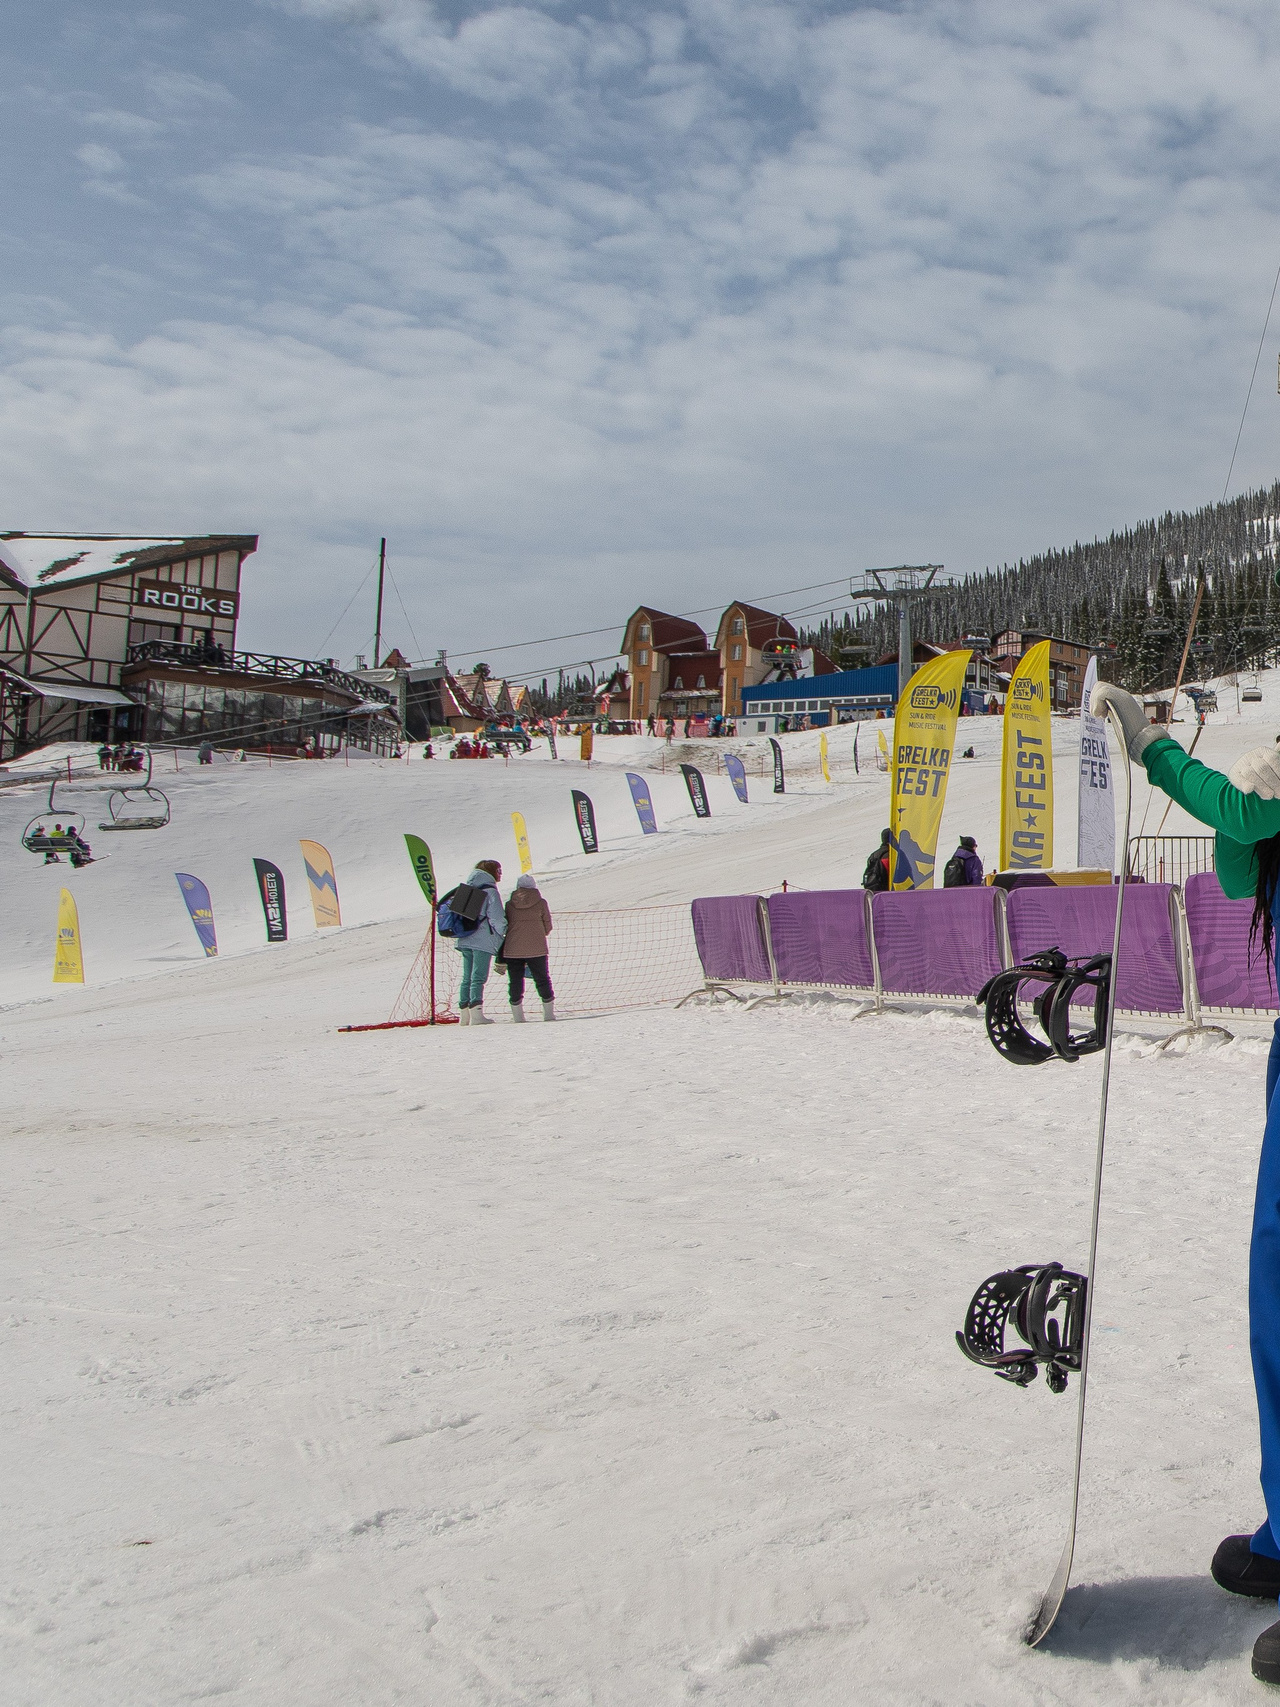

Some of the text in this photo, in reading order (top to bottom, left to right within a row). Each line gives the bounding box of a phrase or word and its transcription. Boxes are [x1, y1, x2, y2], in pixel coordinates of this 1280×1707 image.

[180, 585, 203, 595] THE
[144, 588, 235, 615] ROOKS
[915, 688, 938, 698] GRELKA
[913, 697, 930, 706] FEST
[908, 721, 947, 731] MUSIC FESTIVAL
[897, 745, 951, 768] GRELKA
[1015, 729, 1046, 810] FEST
[896, 766, 947, 798] FEST
